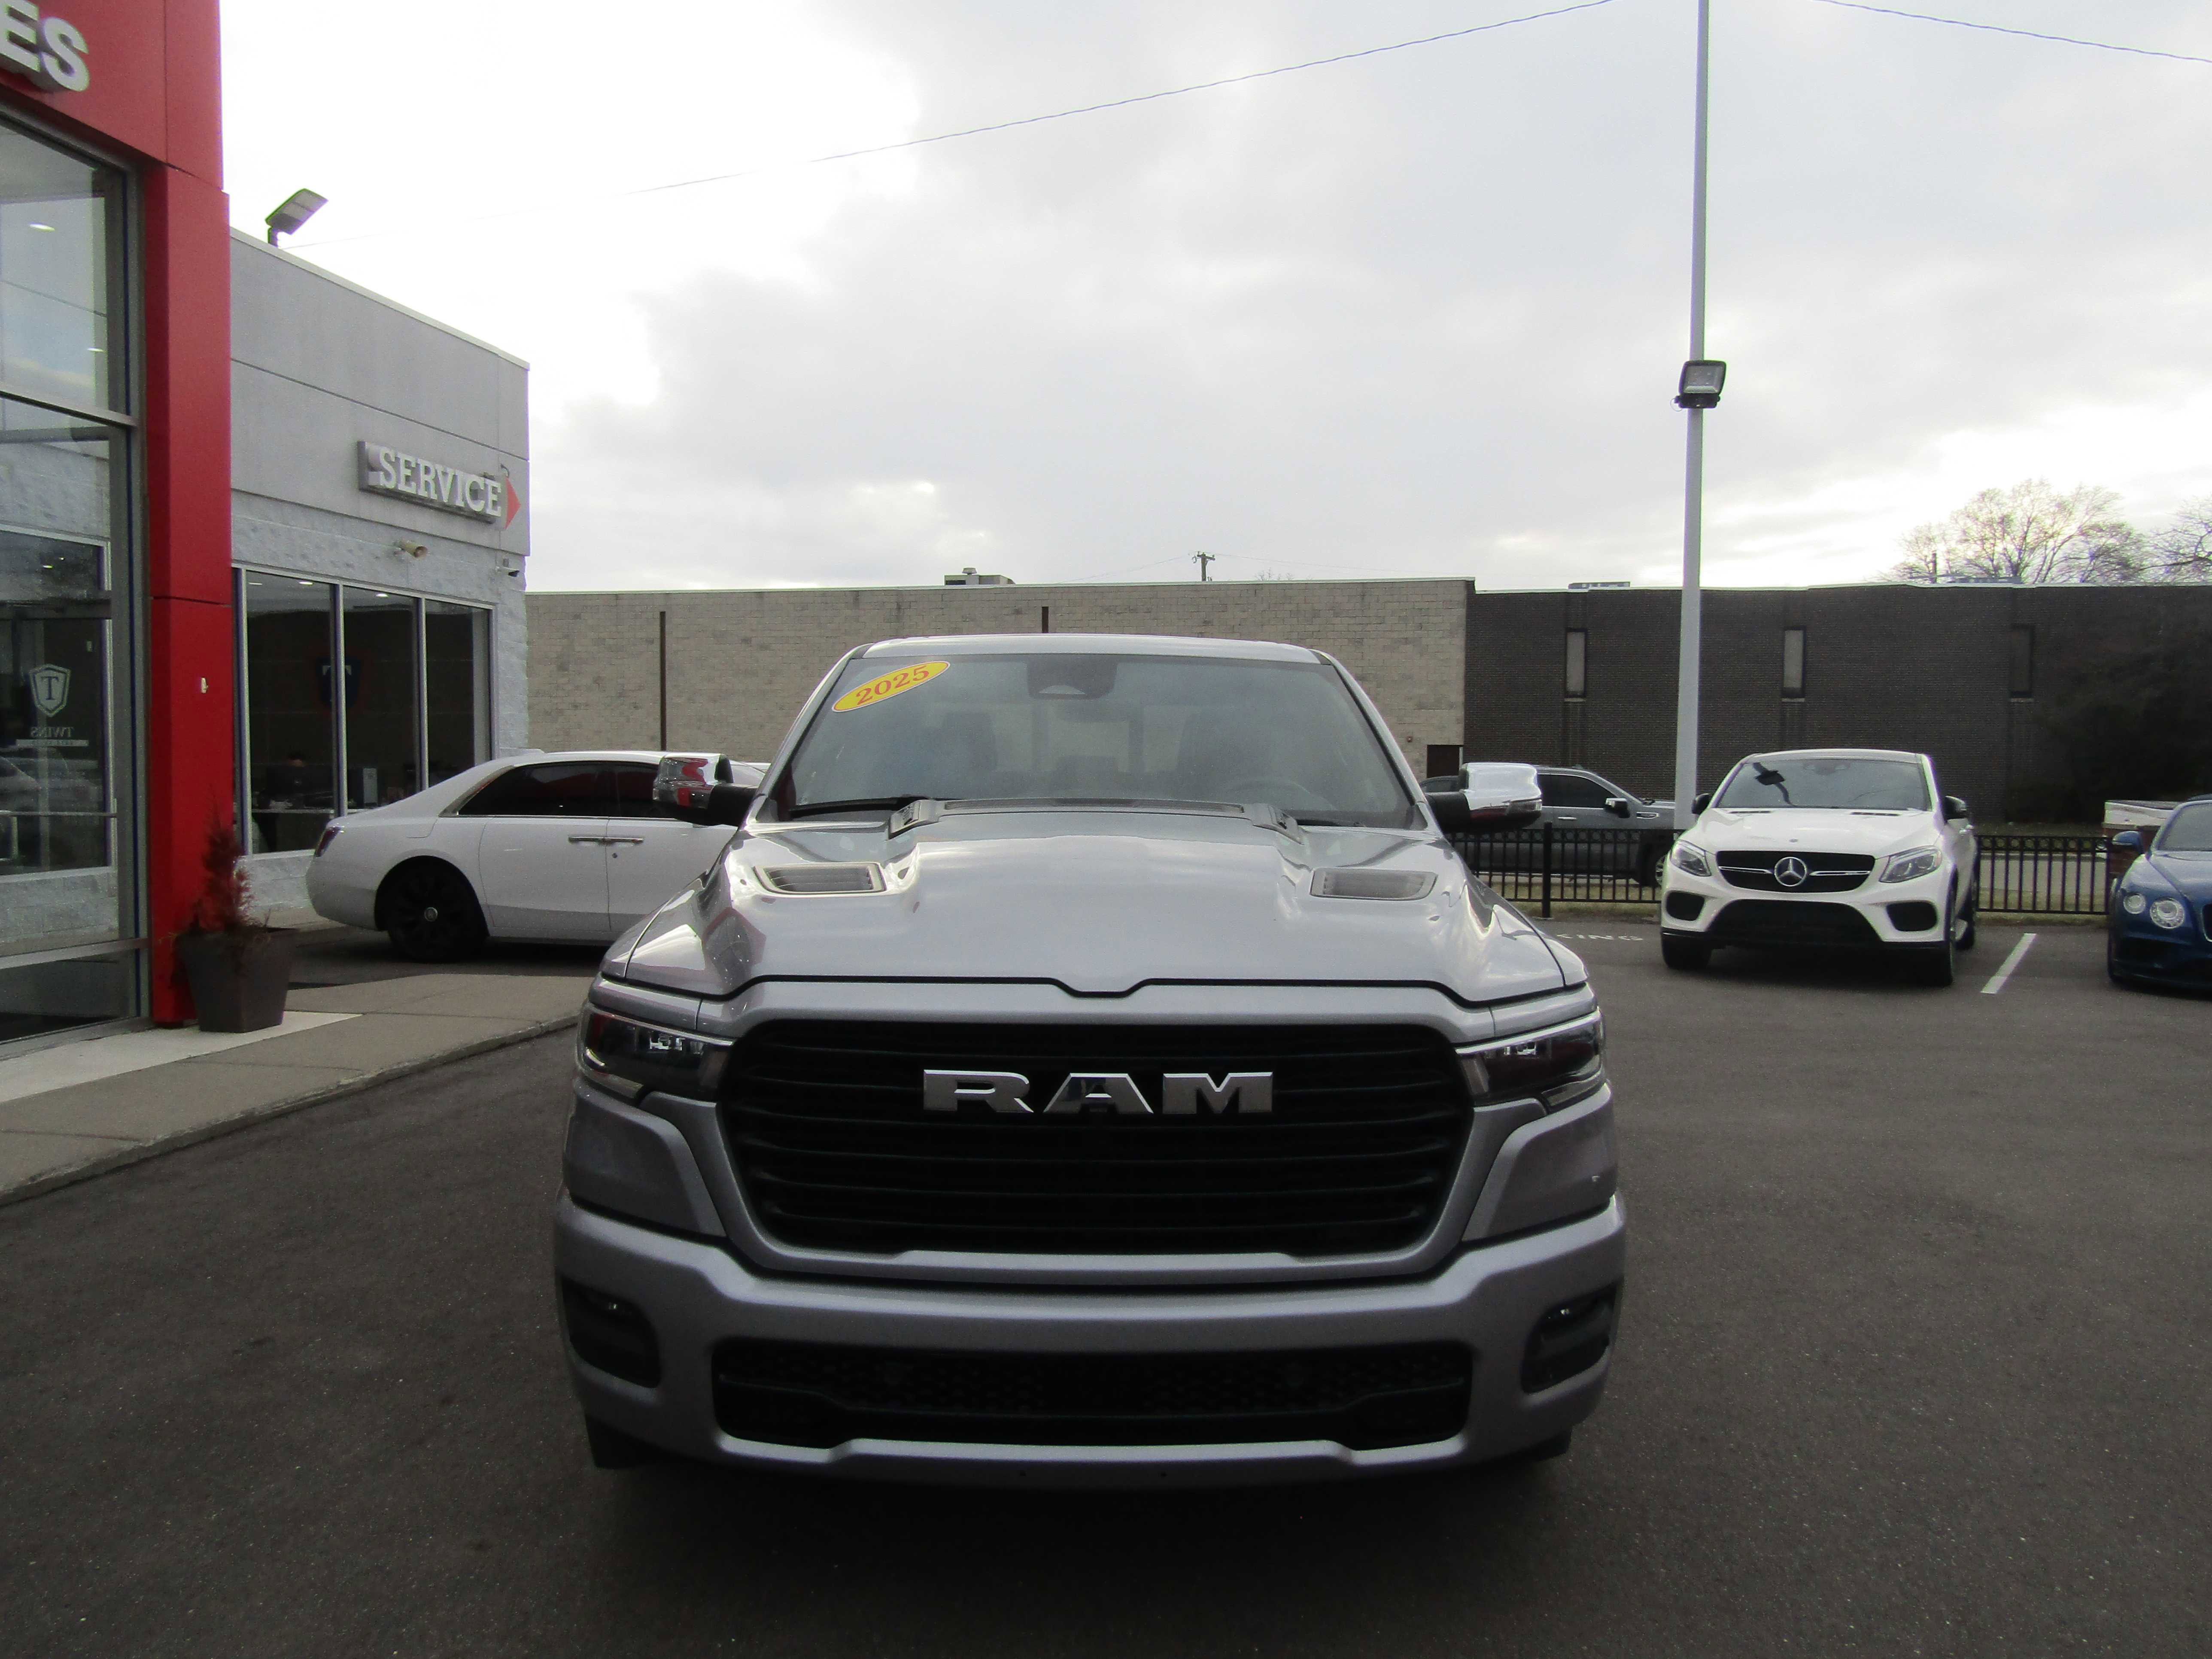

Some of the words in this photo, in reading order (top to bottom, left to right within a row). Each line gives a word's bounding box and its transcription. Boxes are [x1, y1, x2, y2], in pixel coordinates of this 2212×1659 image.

[373, 447, 501, 517] SERVICE
[856, 665, 929, 705] 2025
[924, 1069, 1273, 1114] RAM
